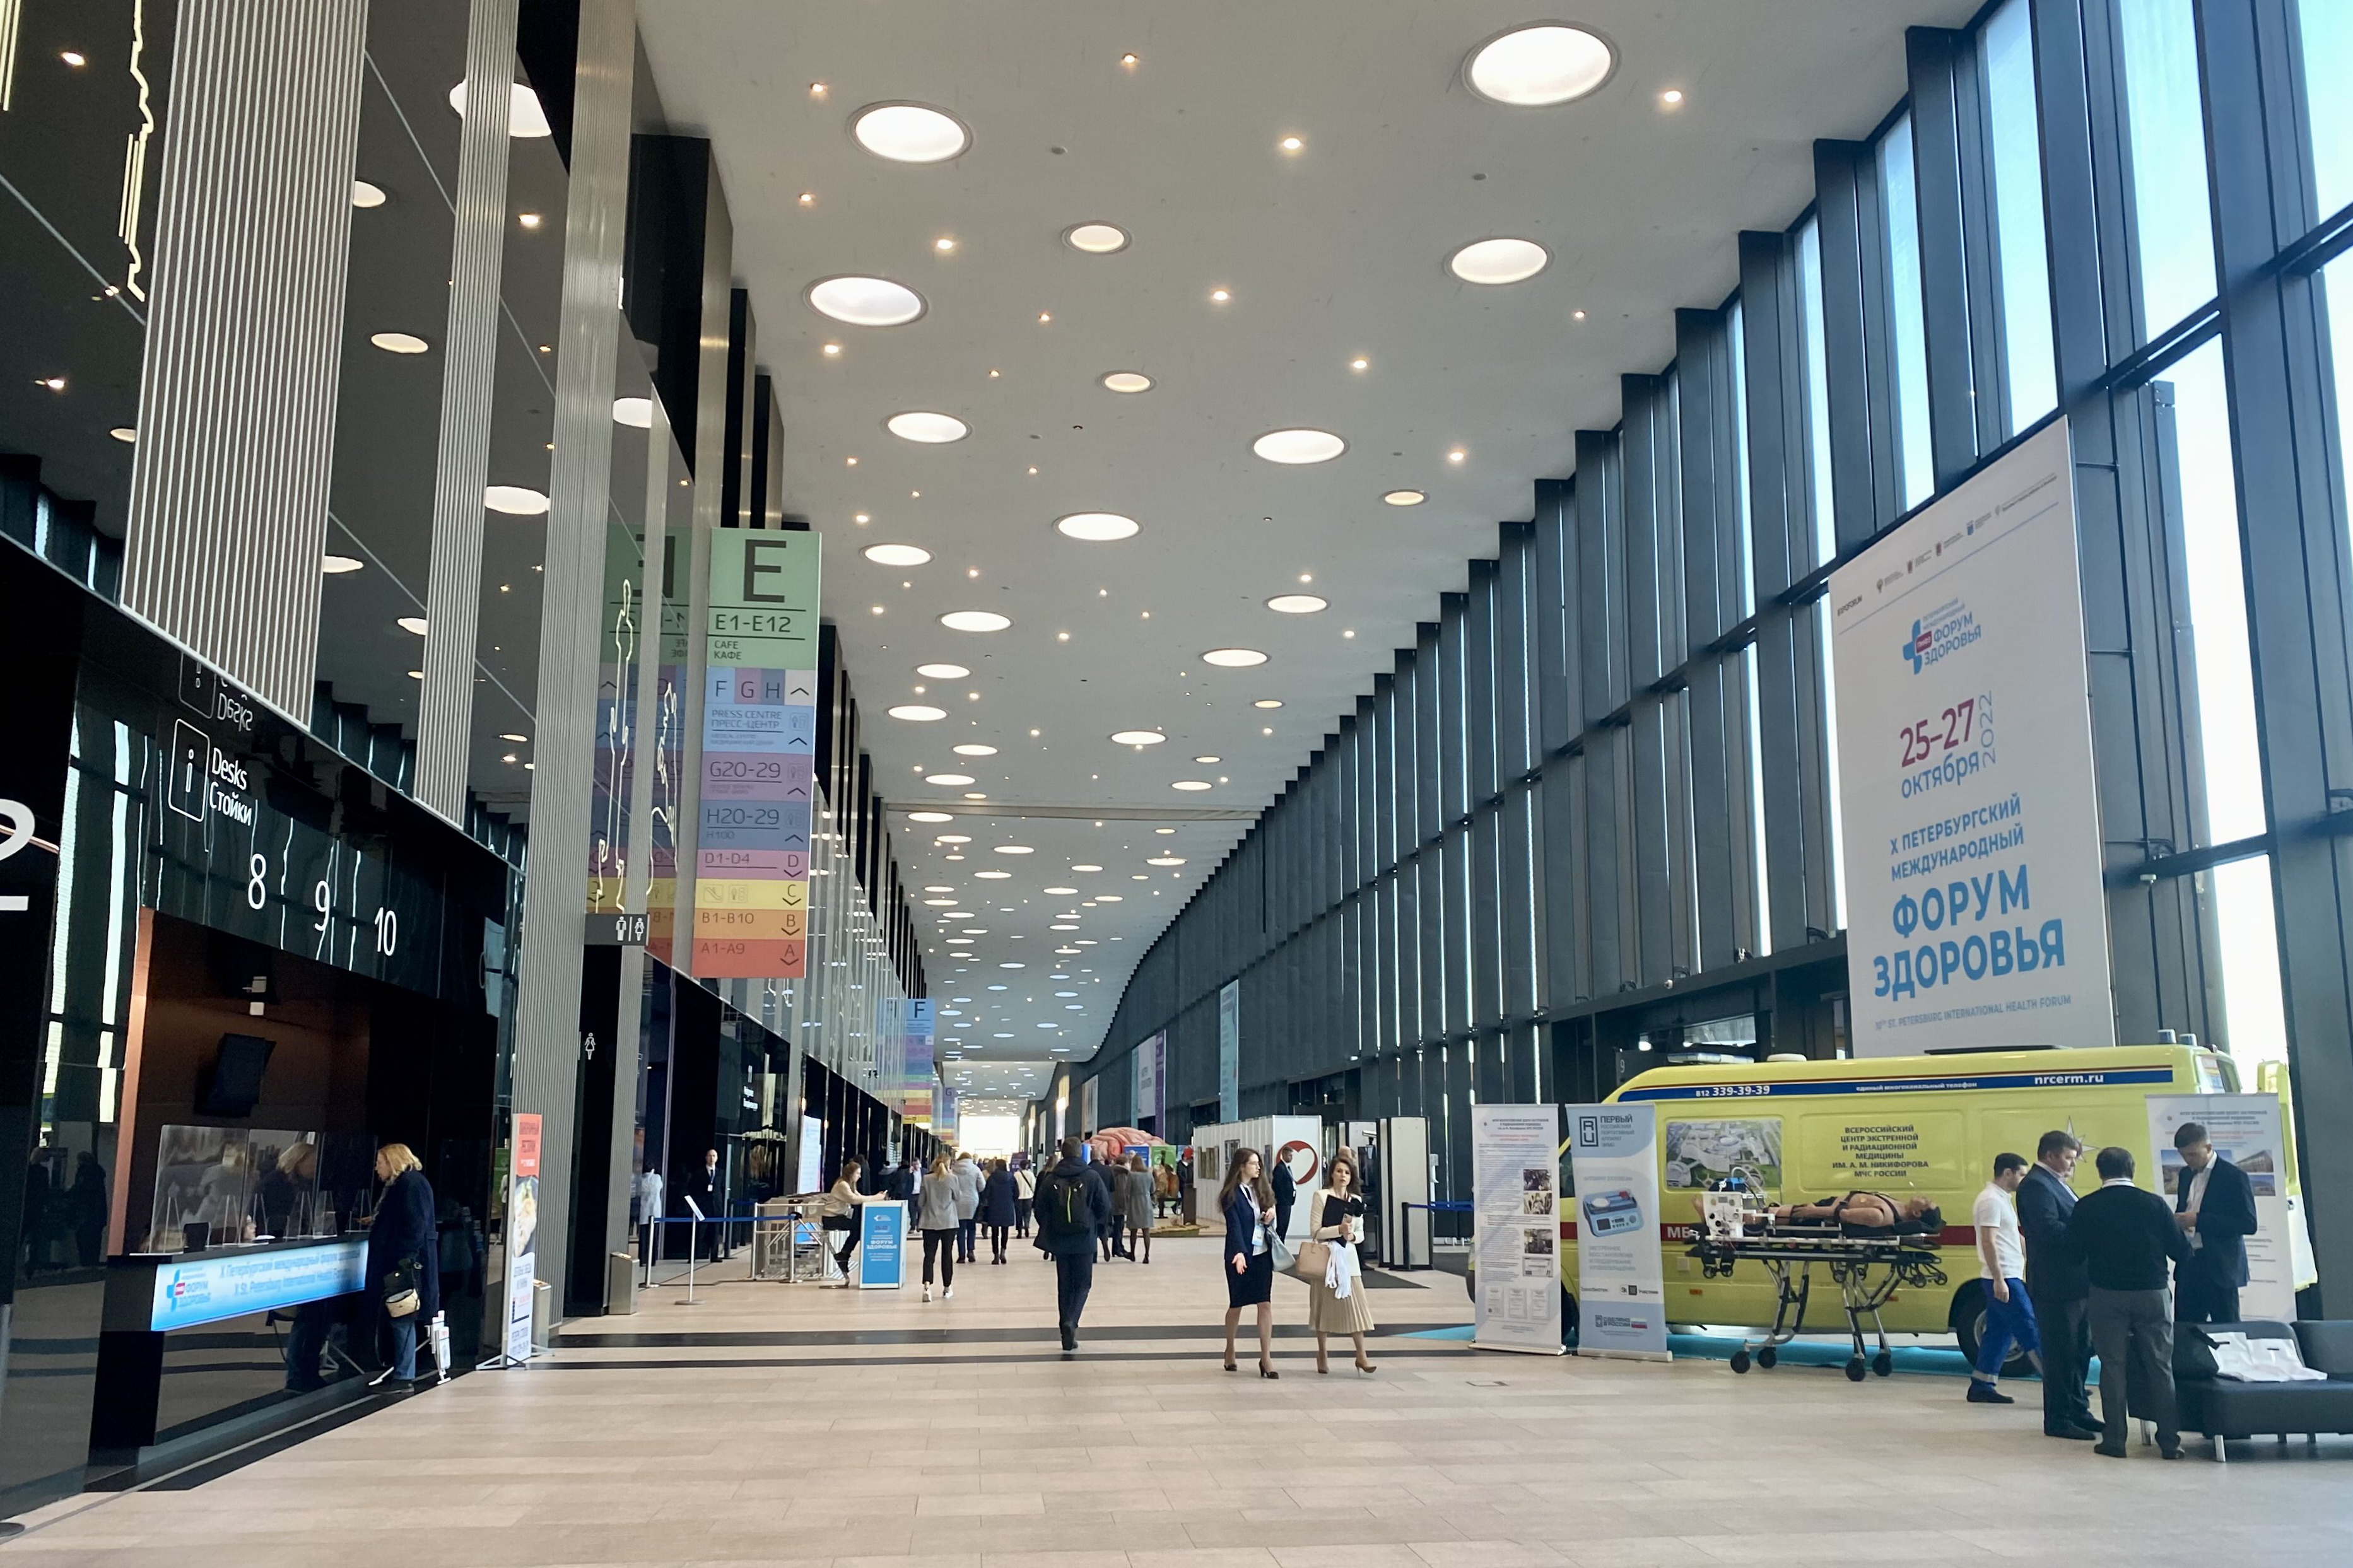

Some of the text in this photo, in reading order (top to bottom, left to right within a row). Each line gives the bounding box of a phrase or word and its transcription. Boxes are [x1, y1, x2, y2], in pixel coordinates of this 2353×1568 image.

[743, 539, 787, 603] E
[715, 614, 791, 633] E1-E12
[1933, 611, 1973, 642] ФОРУМ
[714, 640, 739, 650] CAFE
[1925, 624, 1981, 665] ЗДОРОВЬЯ
[714, 650, 742, 660] КАФЕ
[715, 680, 780, 699] F G H
[712, 710, 782, 720] PRESS CENTRE
[711, 719, 780, 729] ПРЕСС-ЦЕНТР
[1978, 690, 1996, 768] 2022
[1900, 698, 1975, 768] 25-27
[211, 747, 247, 790] Desks
[710, 761, 781, 778] G20-29
[1901, 751, 1980, 799] октября
[209, 781, 252, 826] Стойки
[707, 808, 780, 825] H20-29
[1890, 792, 2021, 855] X ПЕТЕРБУРГСКИЙ
[705, 853, 799, 867] D1-D4 D
[1891, 822, 2024, 881] МЕЖДУНАРОДНЫЙ
[787, 884, 797, 898] C
[248, 853, 397, 956] 8 9 10
[1893, 863, 2030, 939] ФОРУМ
[702, 912, 796, 928] B1-B10 B
[701, 942, 795, 957] A1-A9 A
[1874, 918, 2065, 1002] ЗДОРОВЬЯ
[915, 1002, 926, 1019] F
[2005, 998, 2038, 1012] HEALTH
[2039, 995, 2072, 1009] FORUM
[1620, 1058, 1626, 1073] 9
[2034, 1074, 2104, 1085] nrcerm.ru
[1713, 1085, 1770, 1096] 339-39-39
[1600, 1114, 1633, 1123] ПЕРВЫЙ
[1845, 1125, 1914, 1134] ВСЕРОССИЙСКИЙ
[1867, 1133, 1918, 1142] ЭКСТРЕННОЙ
[1850, 1142, 1917, 1151] РАДИАЦИОННОЙ
